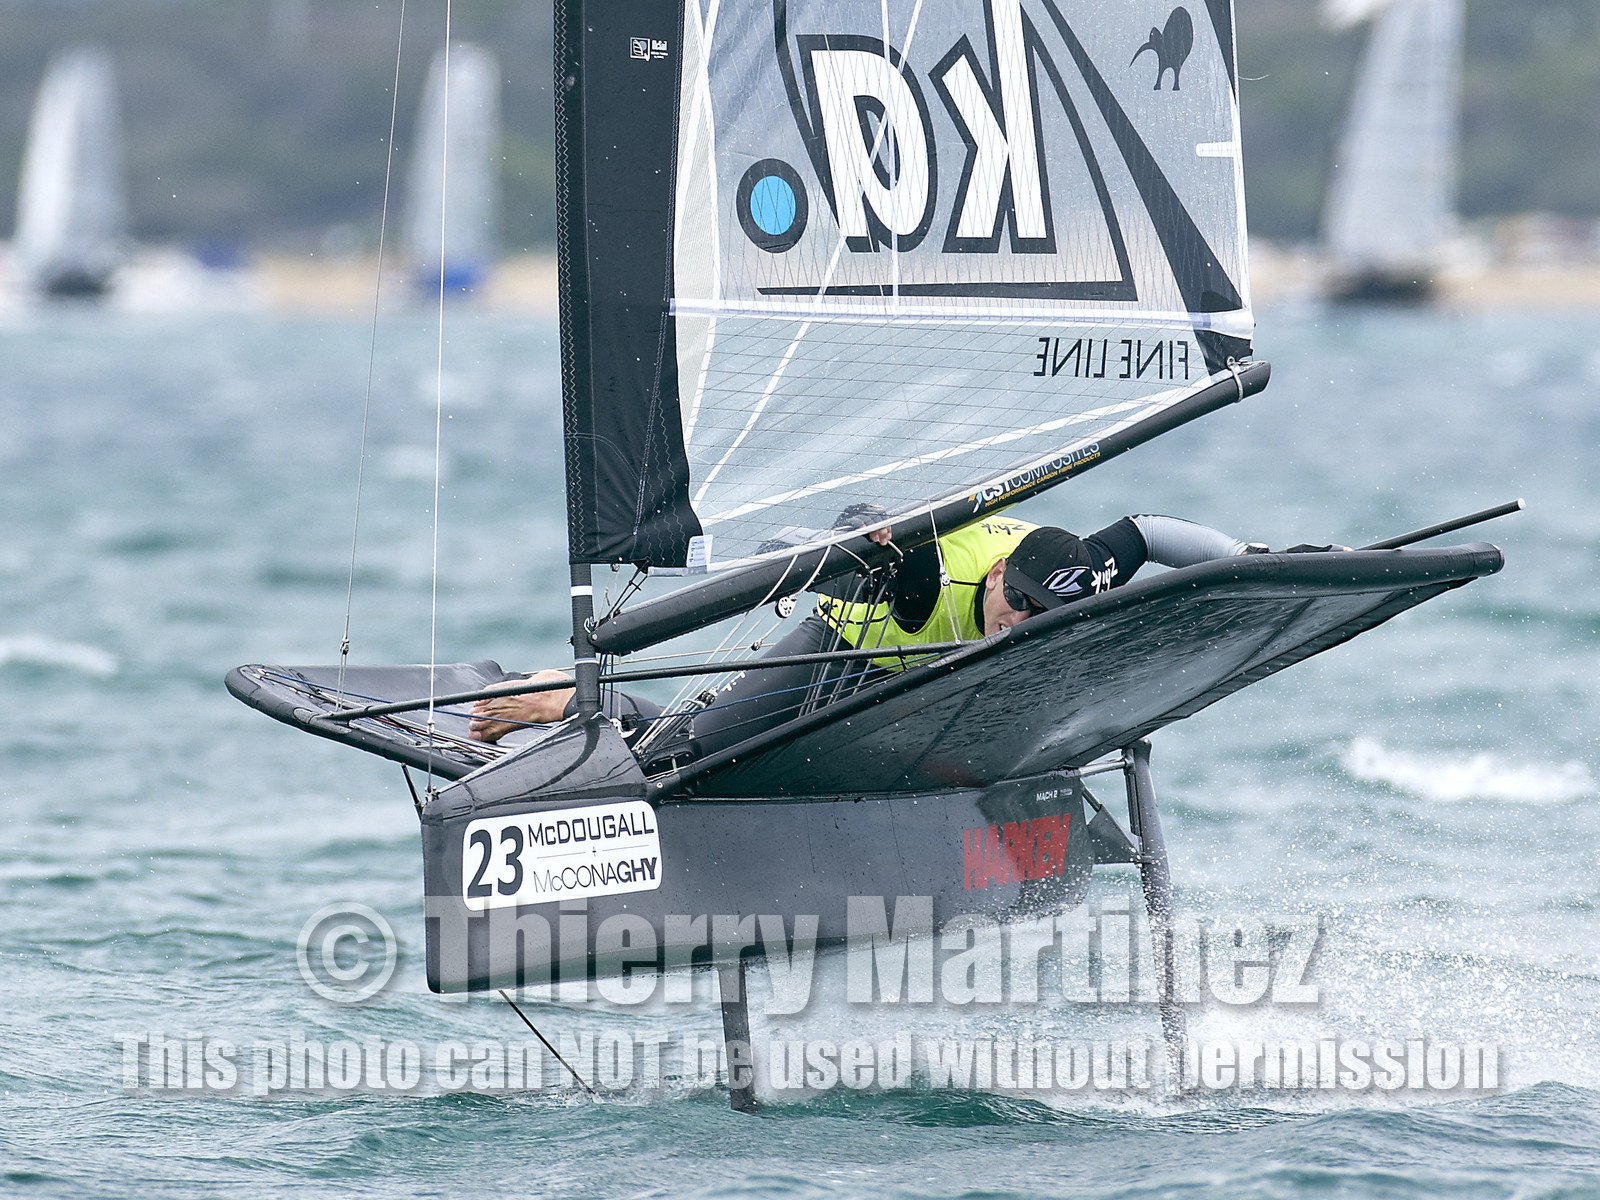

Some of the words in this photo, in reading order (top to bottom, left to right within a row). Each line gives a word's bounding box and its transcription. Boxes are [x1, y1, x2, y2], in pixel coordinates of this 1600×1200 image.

[1036, 791, 1053, 801] MACH
[467, 825, 524, 900] 23
[528, 811, 655, 848] McDOUGALL
[533, 857, 658, 894] McCONAGHY
[963, 813, 1071, 891] HARKEN
